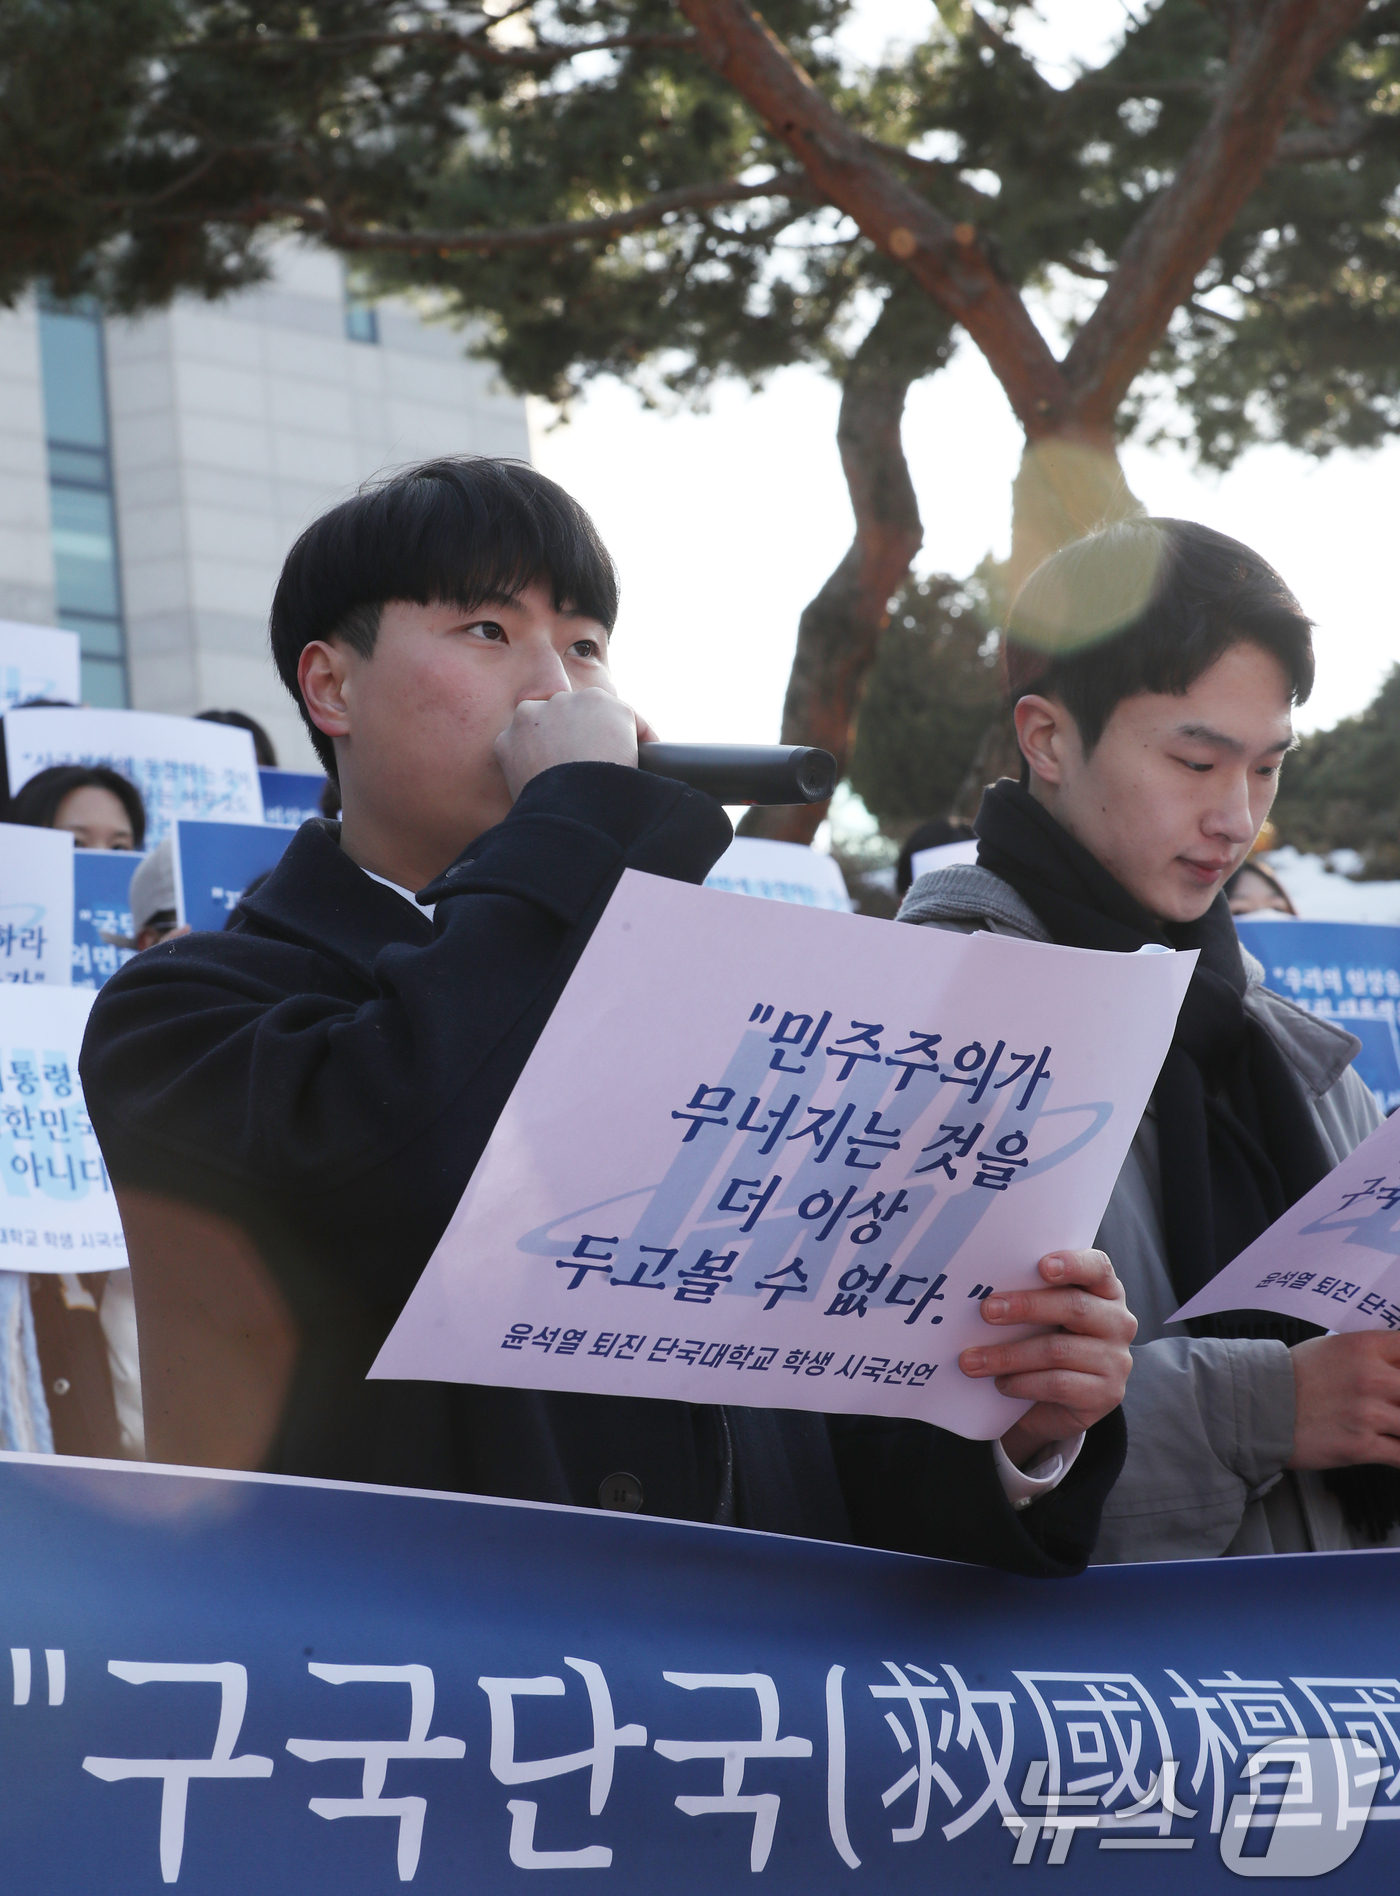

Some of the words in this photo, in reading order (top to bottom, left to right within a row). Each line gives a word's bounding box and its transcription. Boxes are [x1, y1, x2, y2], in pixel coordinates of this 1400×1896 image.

[748, 1002, 1052, 1111] "민주주의가
[671, 1083, 901, 1170] 무너지는
[915, 1122, 1029, 1191] 것을
[717, 1174, 783, 1233] 더
[797, 1184, 909, 1245] 이상
[556, 1233, 740, 1305] 두고볼
[755, 1257, 808, 1311] 수
[1255, 1271, 1317, 1290] 윤석열
[1312, 1276, 1362, 1304] 퇴진
[500, 1323, 588, 1356] 윤석열
[588, 1331, 647, 1361] 퇴진
[647, 1336, 779, 1371] 단국대학교
[782, 1348, 835, 1377] 학생
[834, 1353, 939, 1387] 시국선언
